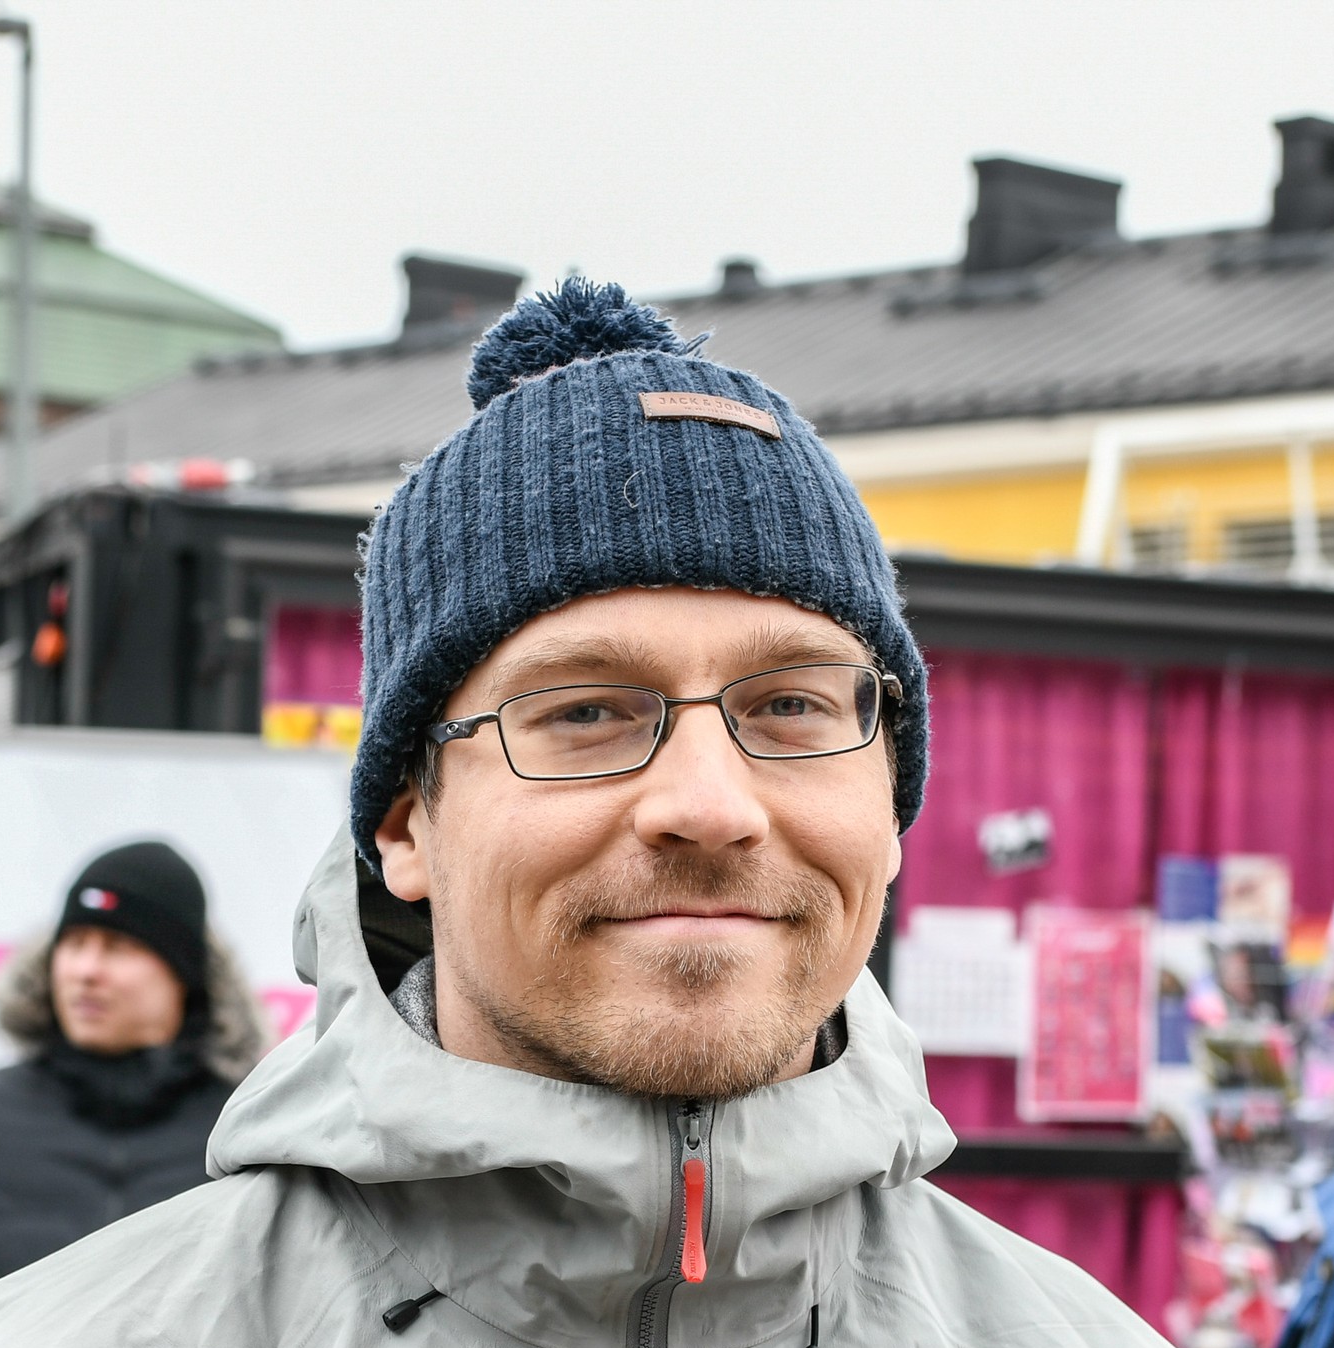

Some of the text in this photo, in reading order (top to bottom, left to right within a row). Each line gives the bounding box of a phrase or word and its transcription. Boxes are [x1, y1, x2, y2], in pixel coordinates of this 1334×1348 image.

[658, 397, 699, 406] JACK
[703, 397, 711, 407] &
[715, 400, 763, 420] JONES
